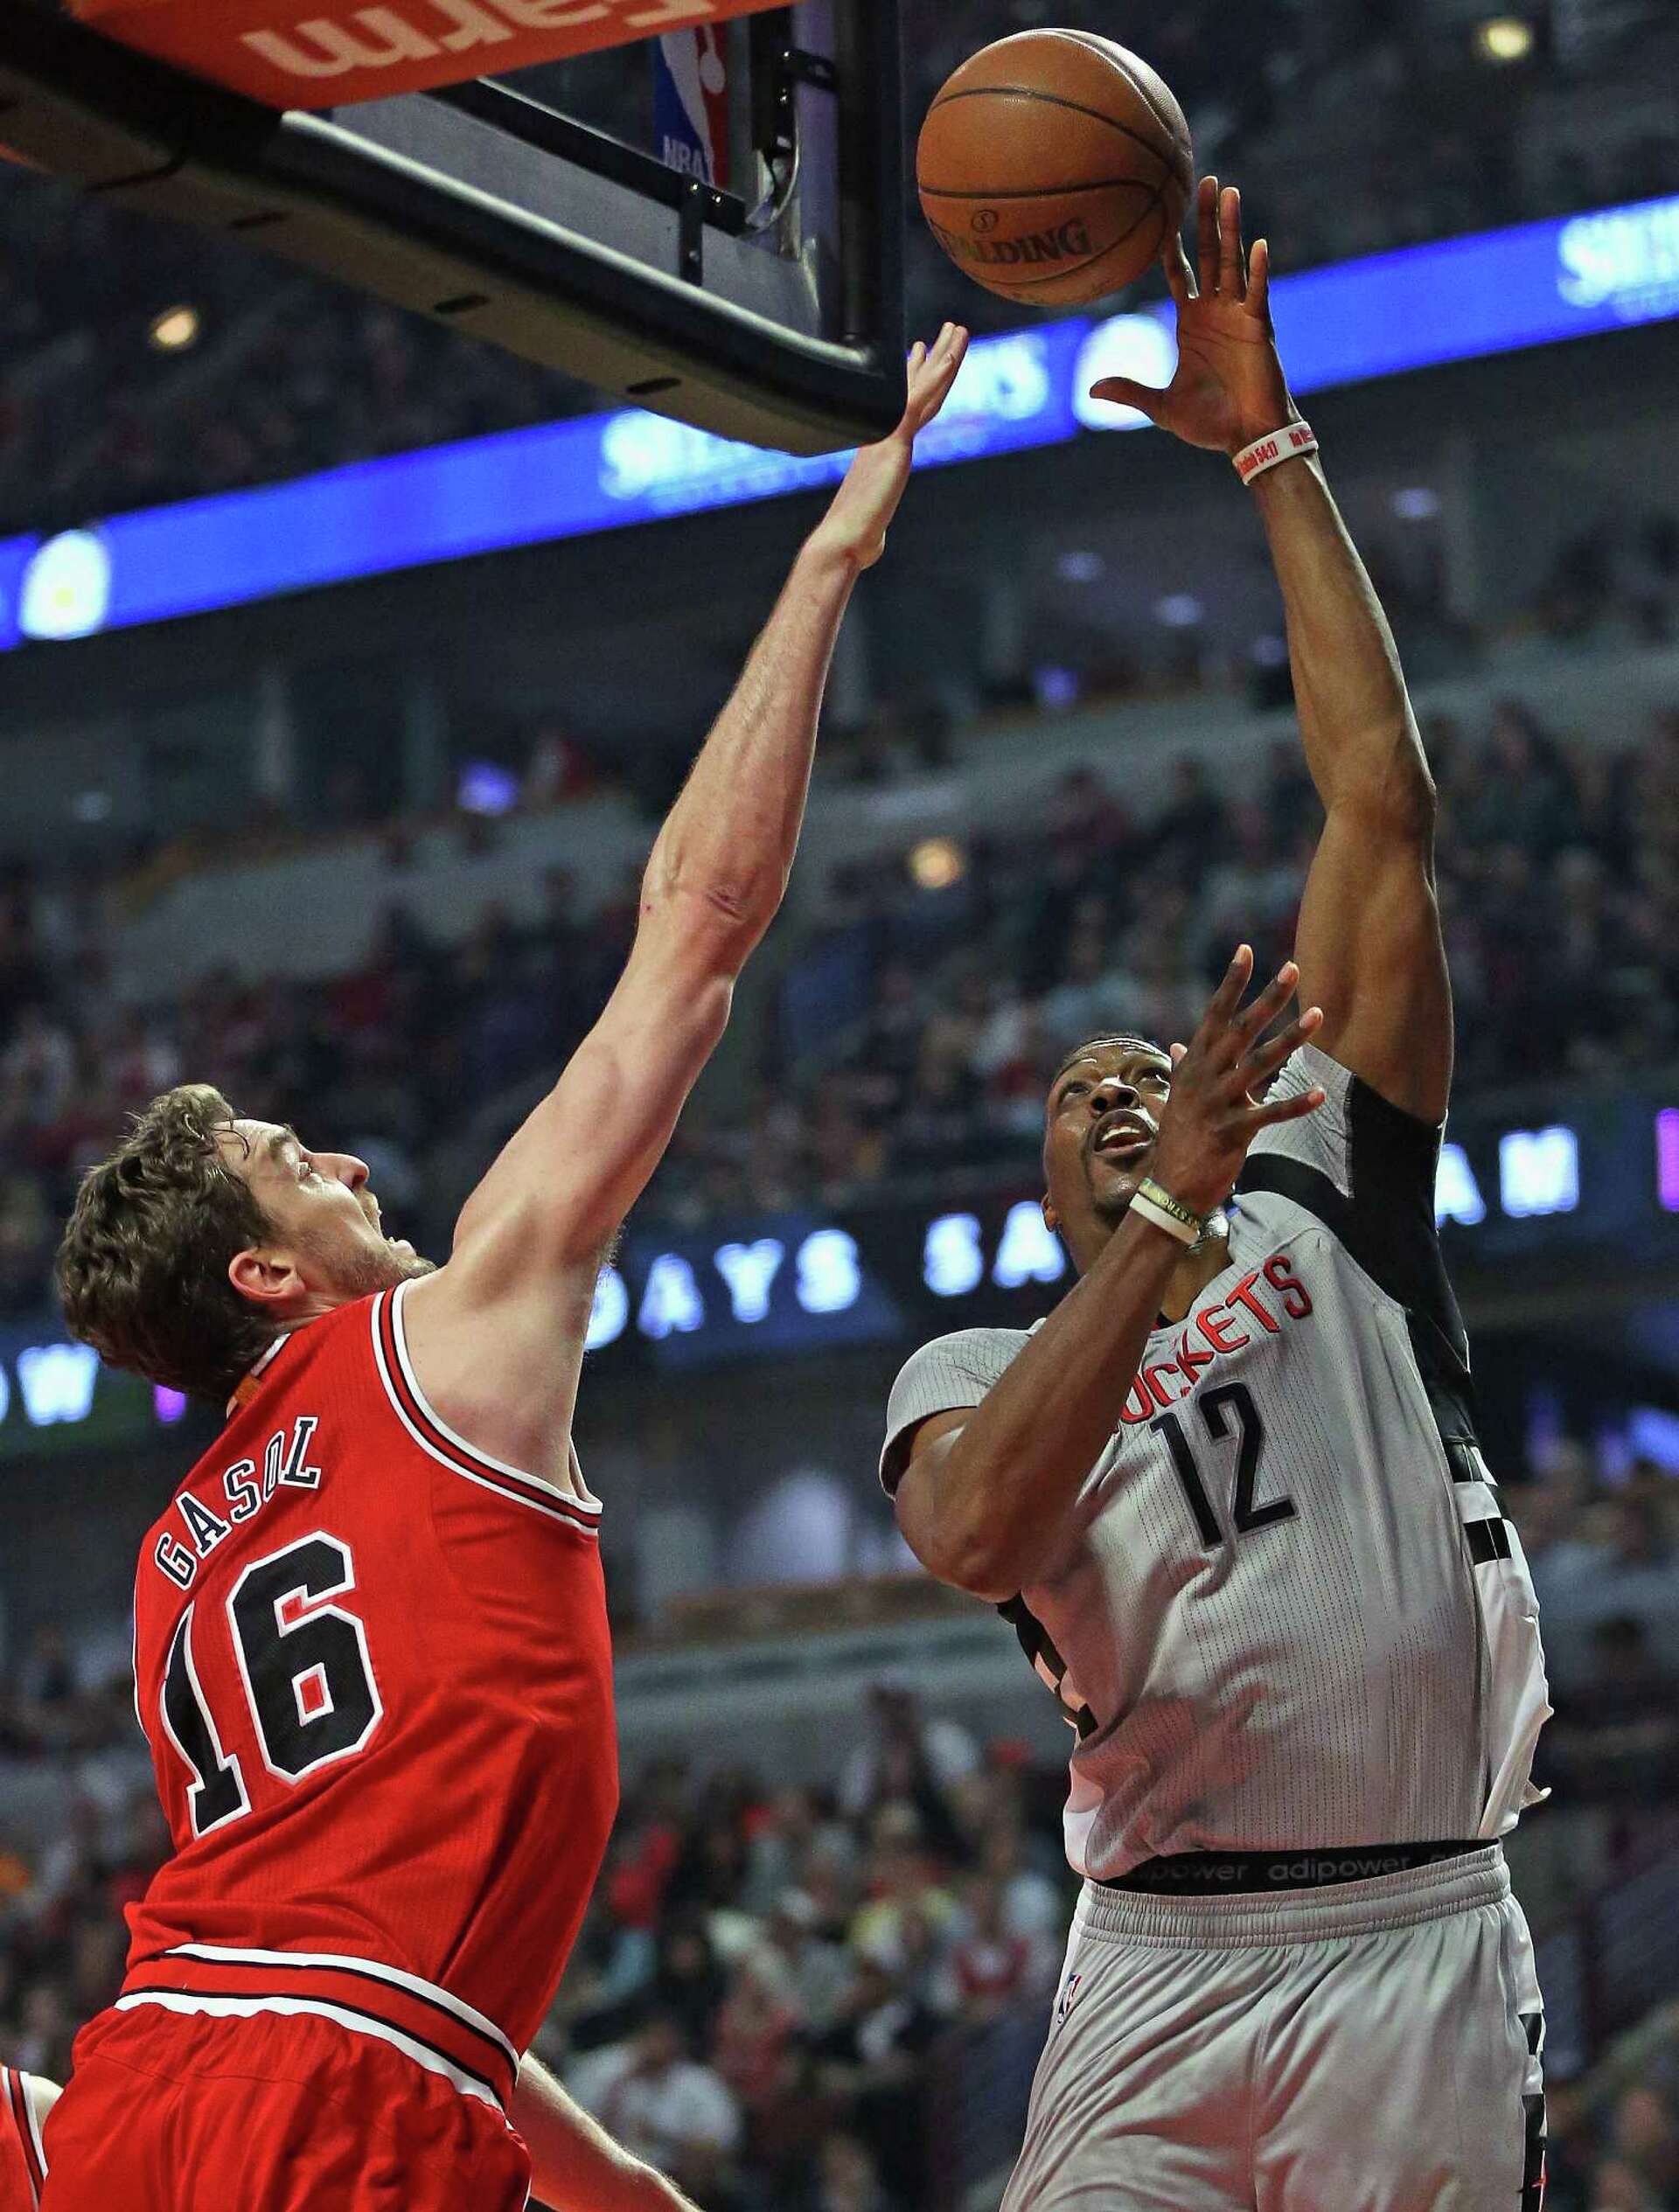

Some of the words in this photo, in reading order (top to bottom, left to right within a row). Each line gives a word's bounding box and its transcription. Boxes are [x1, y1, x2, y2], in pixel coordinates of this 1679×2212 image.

[585, 1228, 860, 1350] DAYS
[924, 1200, 1066, 1297] SA
[1121, 1255, 1313, 1424] OCKETS
[155, 1416, 322, 1590] GASOL
[1148, 1380, 1299, 1553] 12
[159, 1530, 384, 1840] 16
[1267, 1854, 1411, 1885] adipower
